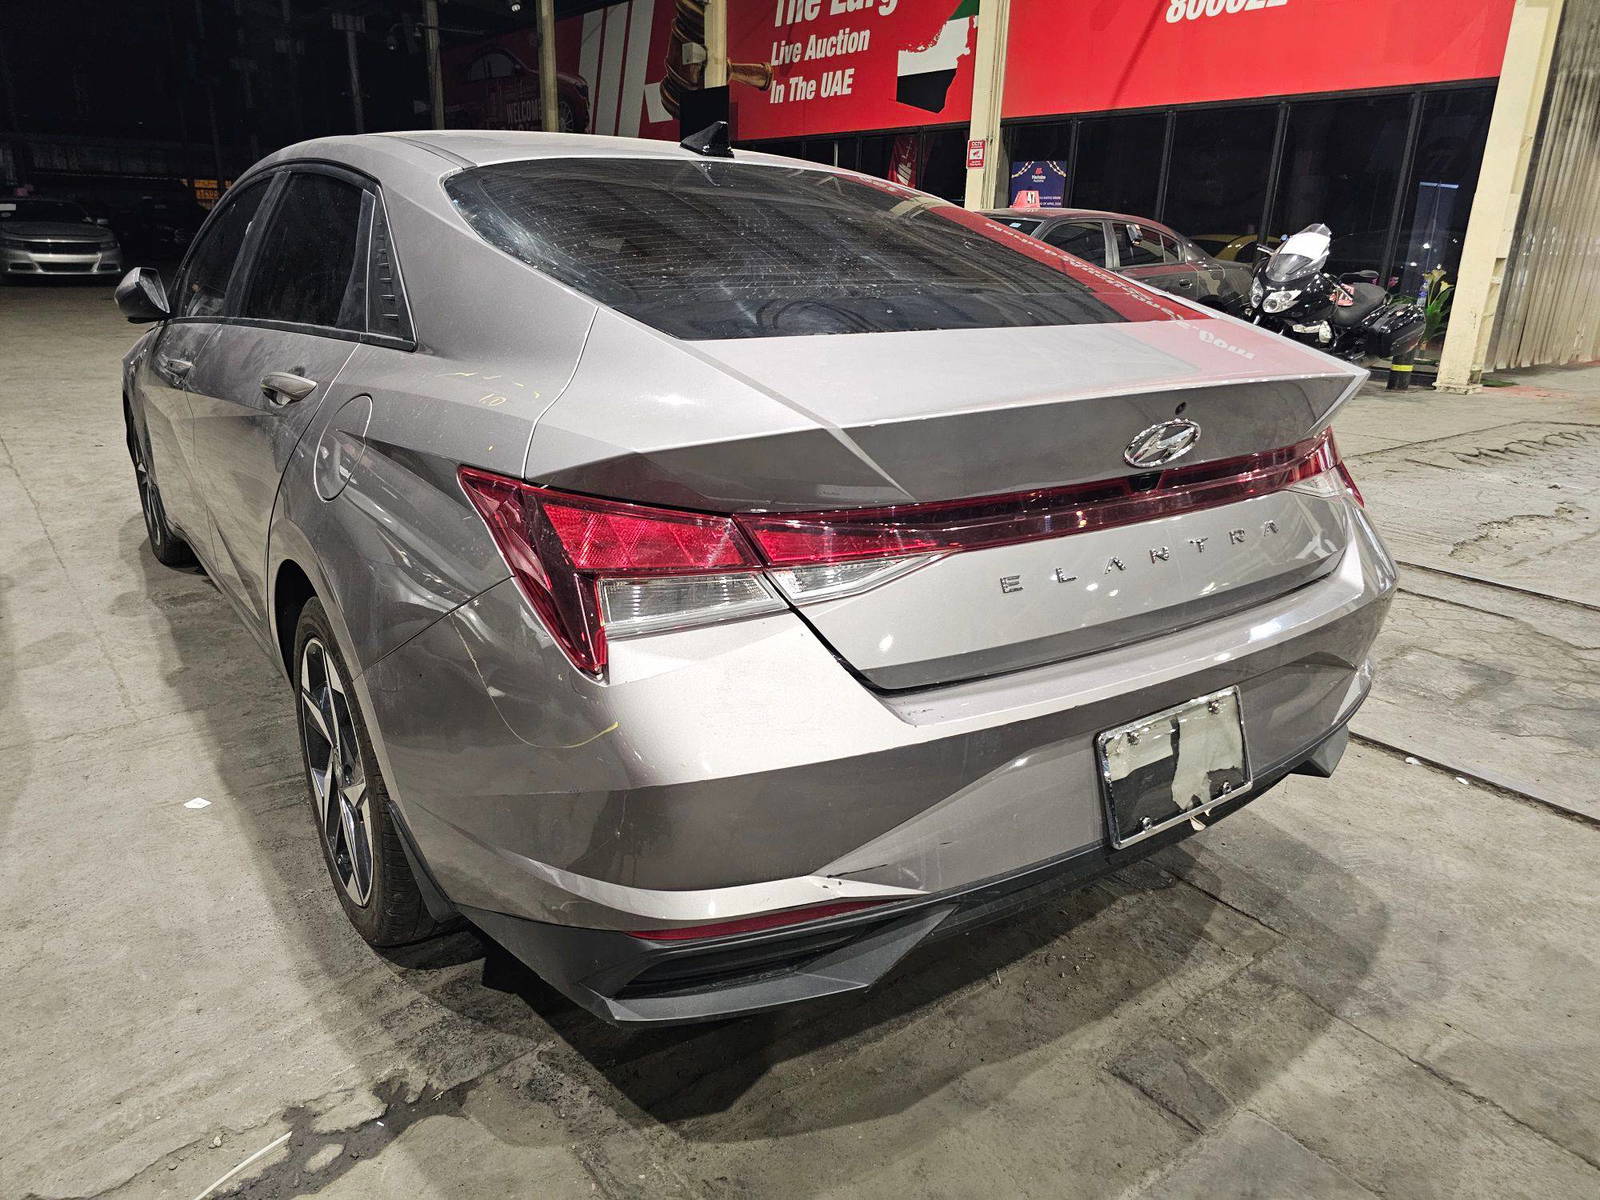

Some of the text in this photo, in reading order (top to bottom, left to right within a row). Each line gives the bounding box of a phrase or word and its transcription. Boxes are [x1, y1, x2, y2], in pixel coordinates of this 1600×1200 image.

[775, 0, 820, 27] The
[771, 28, 870, 66] Live Auction
[770, 68, 855, 104] In The UAE
[1000, 520, 1279, 593] ELANTRA
